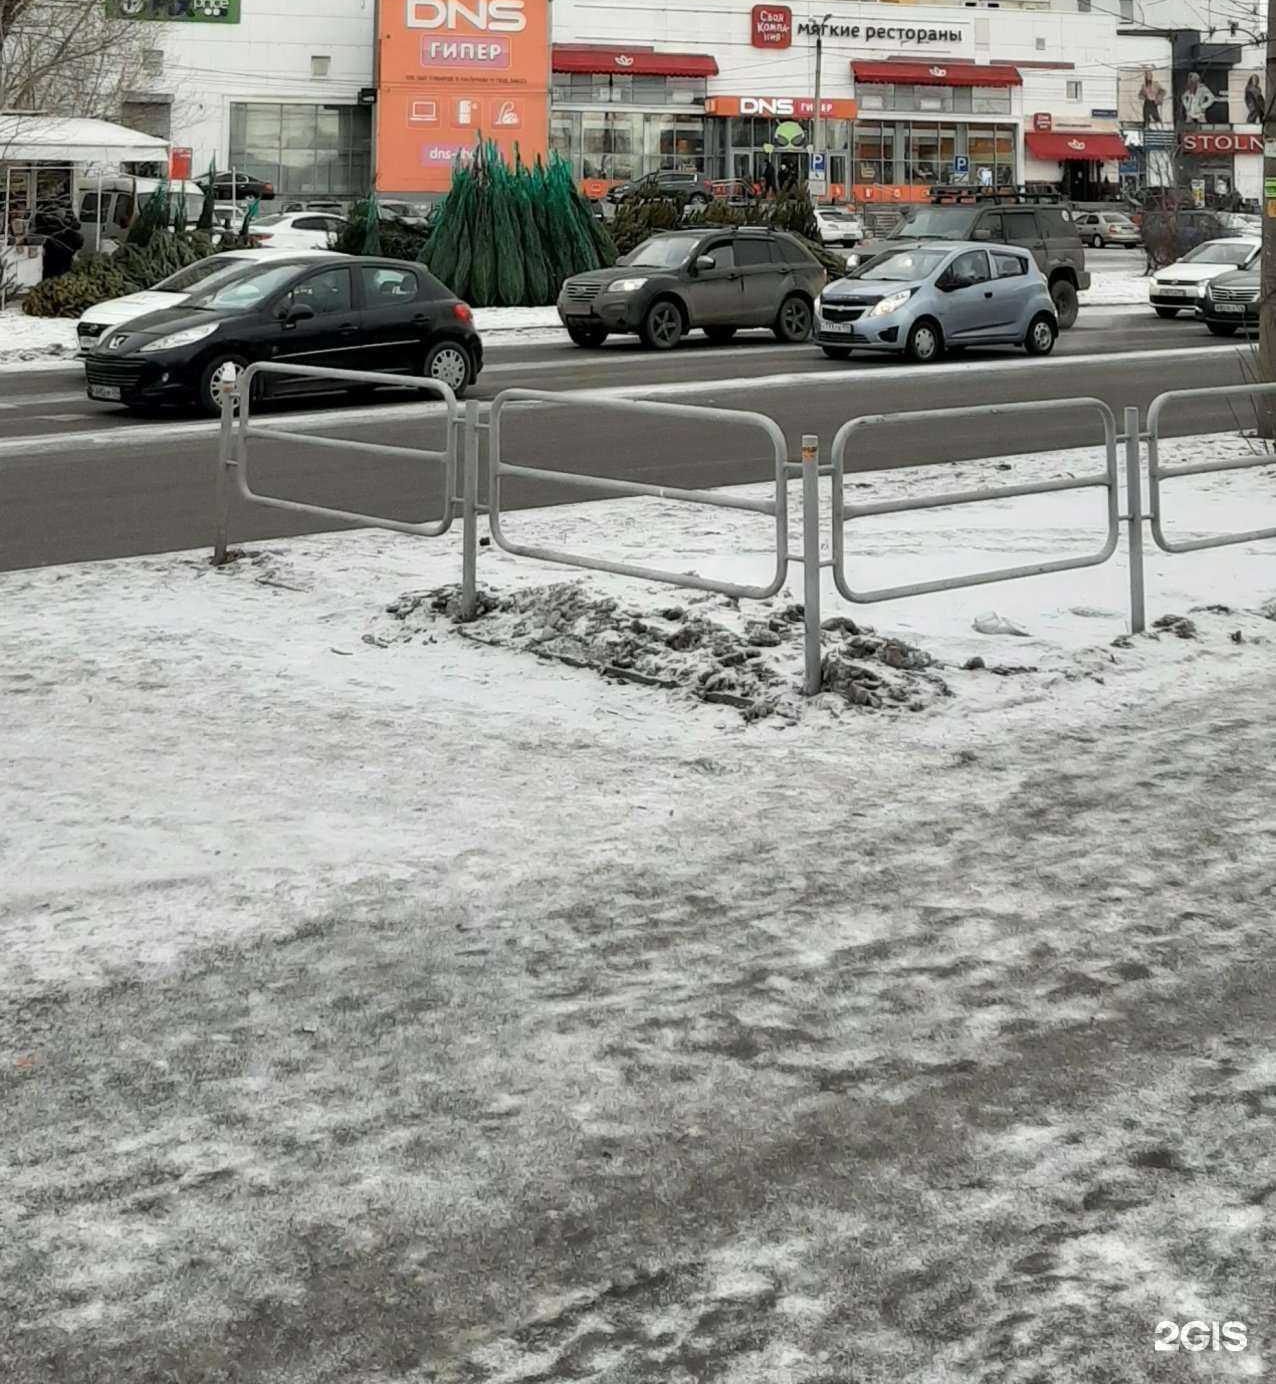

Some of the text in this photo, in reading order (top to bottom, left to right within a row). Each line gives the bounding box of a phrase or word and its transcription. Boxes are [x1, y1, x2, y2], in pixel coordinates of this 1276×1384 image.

[797, 23, 963, 42] мягкие рестораны
[430, 41, 502, 62] ГИПЕР
[739, 97, 795, 115] DNS
[800, 102, 833, 113] ГИЕР
